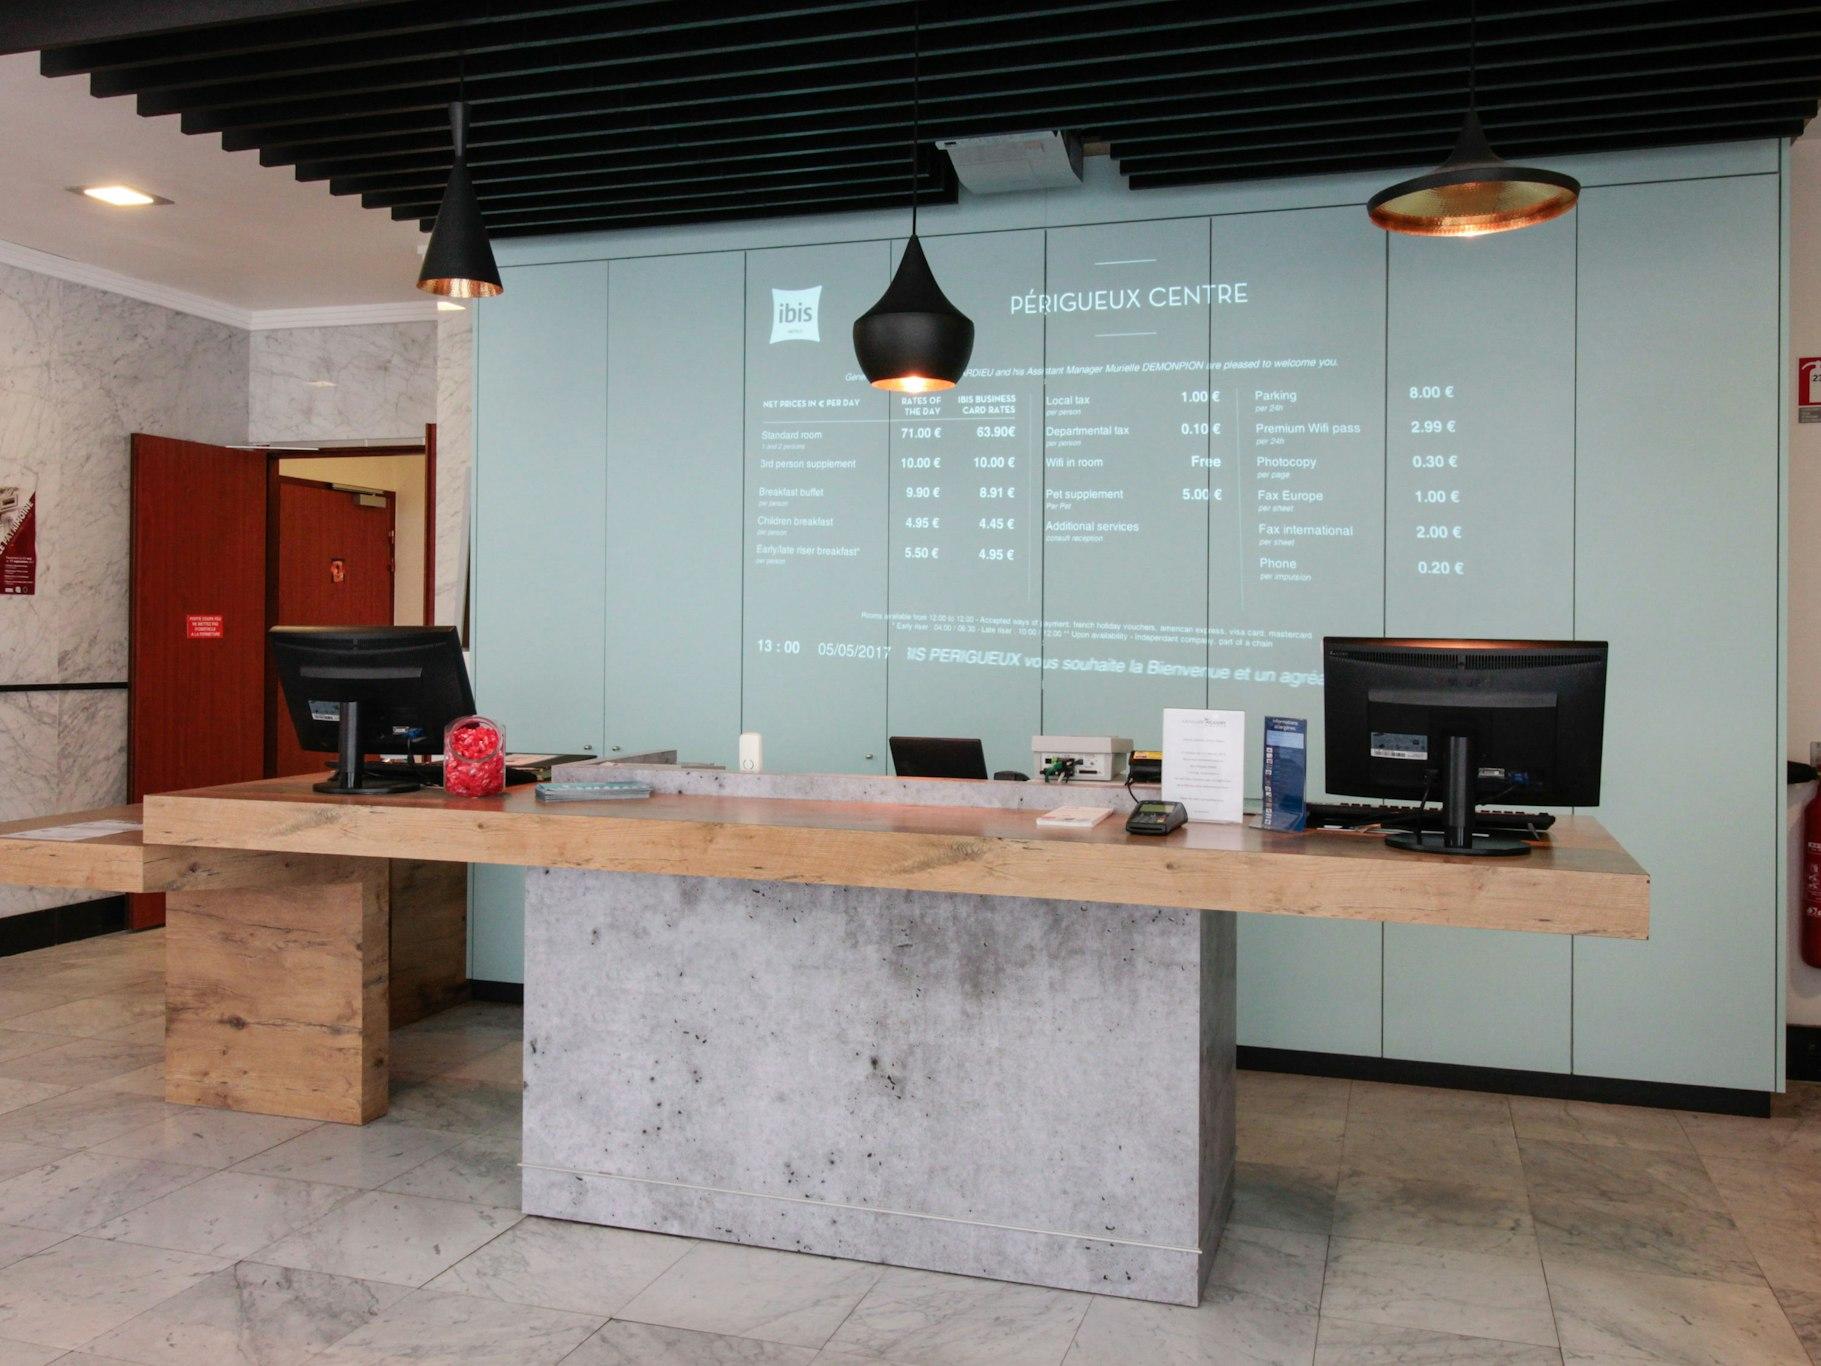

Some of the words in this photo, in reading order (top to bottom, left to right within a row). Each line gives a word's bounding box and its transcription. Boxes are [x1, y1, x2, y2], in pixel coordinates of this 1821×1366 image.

[1011, 288, 1141, 315] PÉRIGUEUX
[1149, 282, 1249, 308] CENTRE
[779, 302, 813, 324] ibis
[995, 367, 1012, 377] and
[1012, 367, 1025, 377] his
[1066, 365, 1104, 377] Manager
[1105, 363, 1140, 374] Murielle
[1223, 359, 1260, 371] pleased
[1262, 359, 1272, 369] to
[1274, 358, 1317, 369] welcome
[1182, 391, 1208, 402] 1.00
[1211, 391, 1221, 402] €
[1254, 390, 1297, 402] Parking
[1409, 386, 1441, 399] 8.00
[1445, 386, 1454, 398] €
[762, 400, 778, 408] NET
[779, 399, 807, 408] PRICES
[808, 399, 817, 407] IN
[826, 398, 842, 407] PER
[843, 398, 861, 407] DAY
[901, 397, 928, 406] RATES
[929, 396, 942, 405] OF
[958, 395, 974, 404] IBIS
[975, 394, 1016, 404] BUSINESS
[1046, 395, 1073, 405] Local
[1075, 395, 1090, 405] tax
[905, 407, 920, 416] THE
[922, 407, 941, 416] DAY
[962, 405, 985, 415] CARD
[988, 404, 1016, 414] RATES
[976, 426, 1016, 438] 63.90€
[1046, 426, 1112, 437] Departmental
[1114, 426, 1129, 435] tax
[1181, 423, 1209, 435] 0.10
[1212, 423, 1221, 435] €
[1255, 423, 1305, 434] Premium
[1308, 422, 1329, 433] Wifi
[1332, 424, 1361, 435] pass
[1411, 421, 1442, 433] 2.99
[1447, 420, 1456, 432] €
[761, 430, 800, 440] Standard
[800, 431, 823, 440] room
[901, 427, 931, 439] 71.00
[933, 427, 942, 438] €
[760, 459, 774, 469] 3rd
[775, 460, 804, 471] person
[806, 459, 856, 470] supplement
[901, 457, 931, 469] 10.00
[933, 457, 941, 468] €
[974, 457, 1004, 468] 10.00
[1007, 457, 1015, 468] €
[1046, 457, 1064, 467] Wifi
[1066, 457, 1075, 467] in
[1078, 459, 1103, 467] room
[1191, 455, 1222, 468] Free
[1256, 456, 1317, 469] Photocopy
[1412, 455, 1444, 468] 0.30
[1449, 455, 1458, 467] €
[758, 487, 798, 497] Breakfast
[799, 486, 824, 497] buffet
[906, 487, 930, 498] 9.90
[932, 487, 940, 498] €
[979, 487, 1003, 498] 8.91
[1007, 487, 1015, 498] €
[1046, 489, 1063, 499] Pet
[1065, 489, 1124, 501] supplement
[1182, 489, 1210, 500] 5.00
[1213, 489, 1222, 500] €
[1258, 490, 1279, 501] Fax
[1282, 490, 1324, 503] Europe
[1415, 490, 1446, 503] 1.00
[1450, 490, 1460, 503] €
[757, 516, 792, 527] Children
[793, 516, 834, 527] breakfast
[905, 517, 929, 528] 4.95
[932, 517, 940, 528] €
[979, 518, 1004, 529] 4.45
[1007, 519, 1015, 530] €
[1046, 521, 1095, 531] Additional
[1096, 521, 1139, 532] services
[1258, 524, 1280, 535] Fax
[1283, 524, 1354, 536] international
[1416, 526, 1448, 538] 2.00
[1452, 526, 1462, 538] €
[904, 547, 929, 559] 5.50
[931, 548, 939, 559] €
[978, 549, 1003, 560] 4.95
[1006, 549, 1015, 560] €
[1260, 557, 1297, 569] Phone
[1417, 561, 1450, 574] 0.20
[1454, 562, 1464, 575] €
[757, 639, 773, 652] 13
[784, 640, 801, 654] 00
[818, 642, 891, 659] 05/05/2017
[929, 648, 1023, 667] PERIGUEUX
[1024, 656, 1059, 670] vous
[1062, 657, 1126, 673] souhaite
[1128, 659, 1143, 674] la
[1146, 660, 1231, 679] Bienvenue
[1233, 667, 1252, 681] et
[1253, 669, 1276, 682] un
